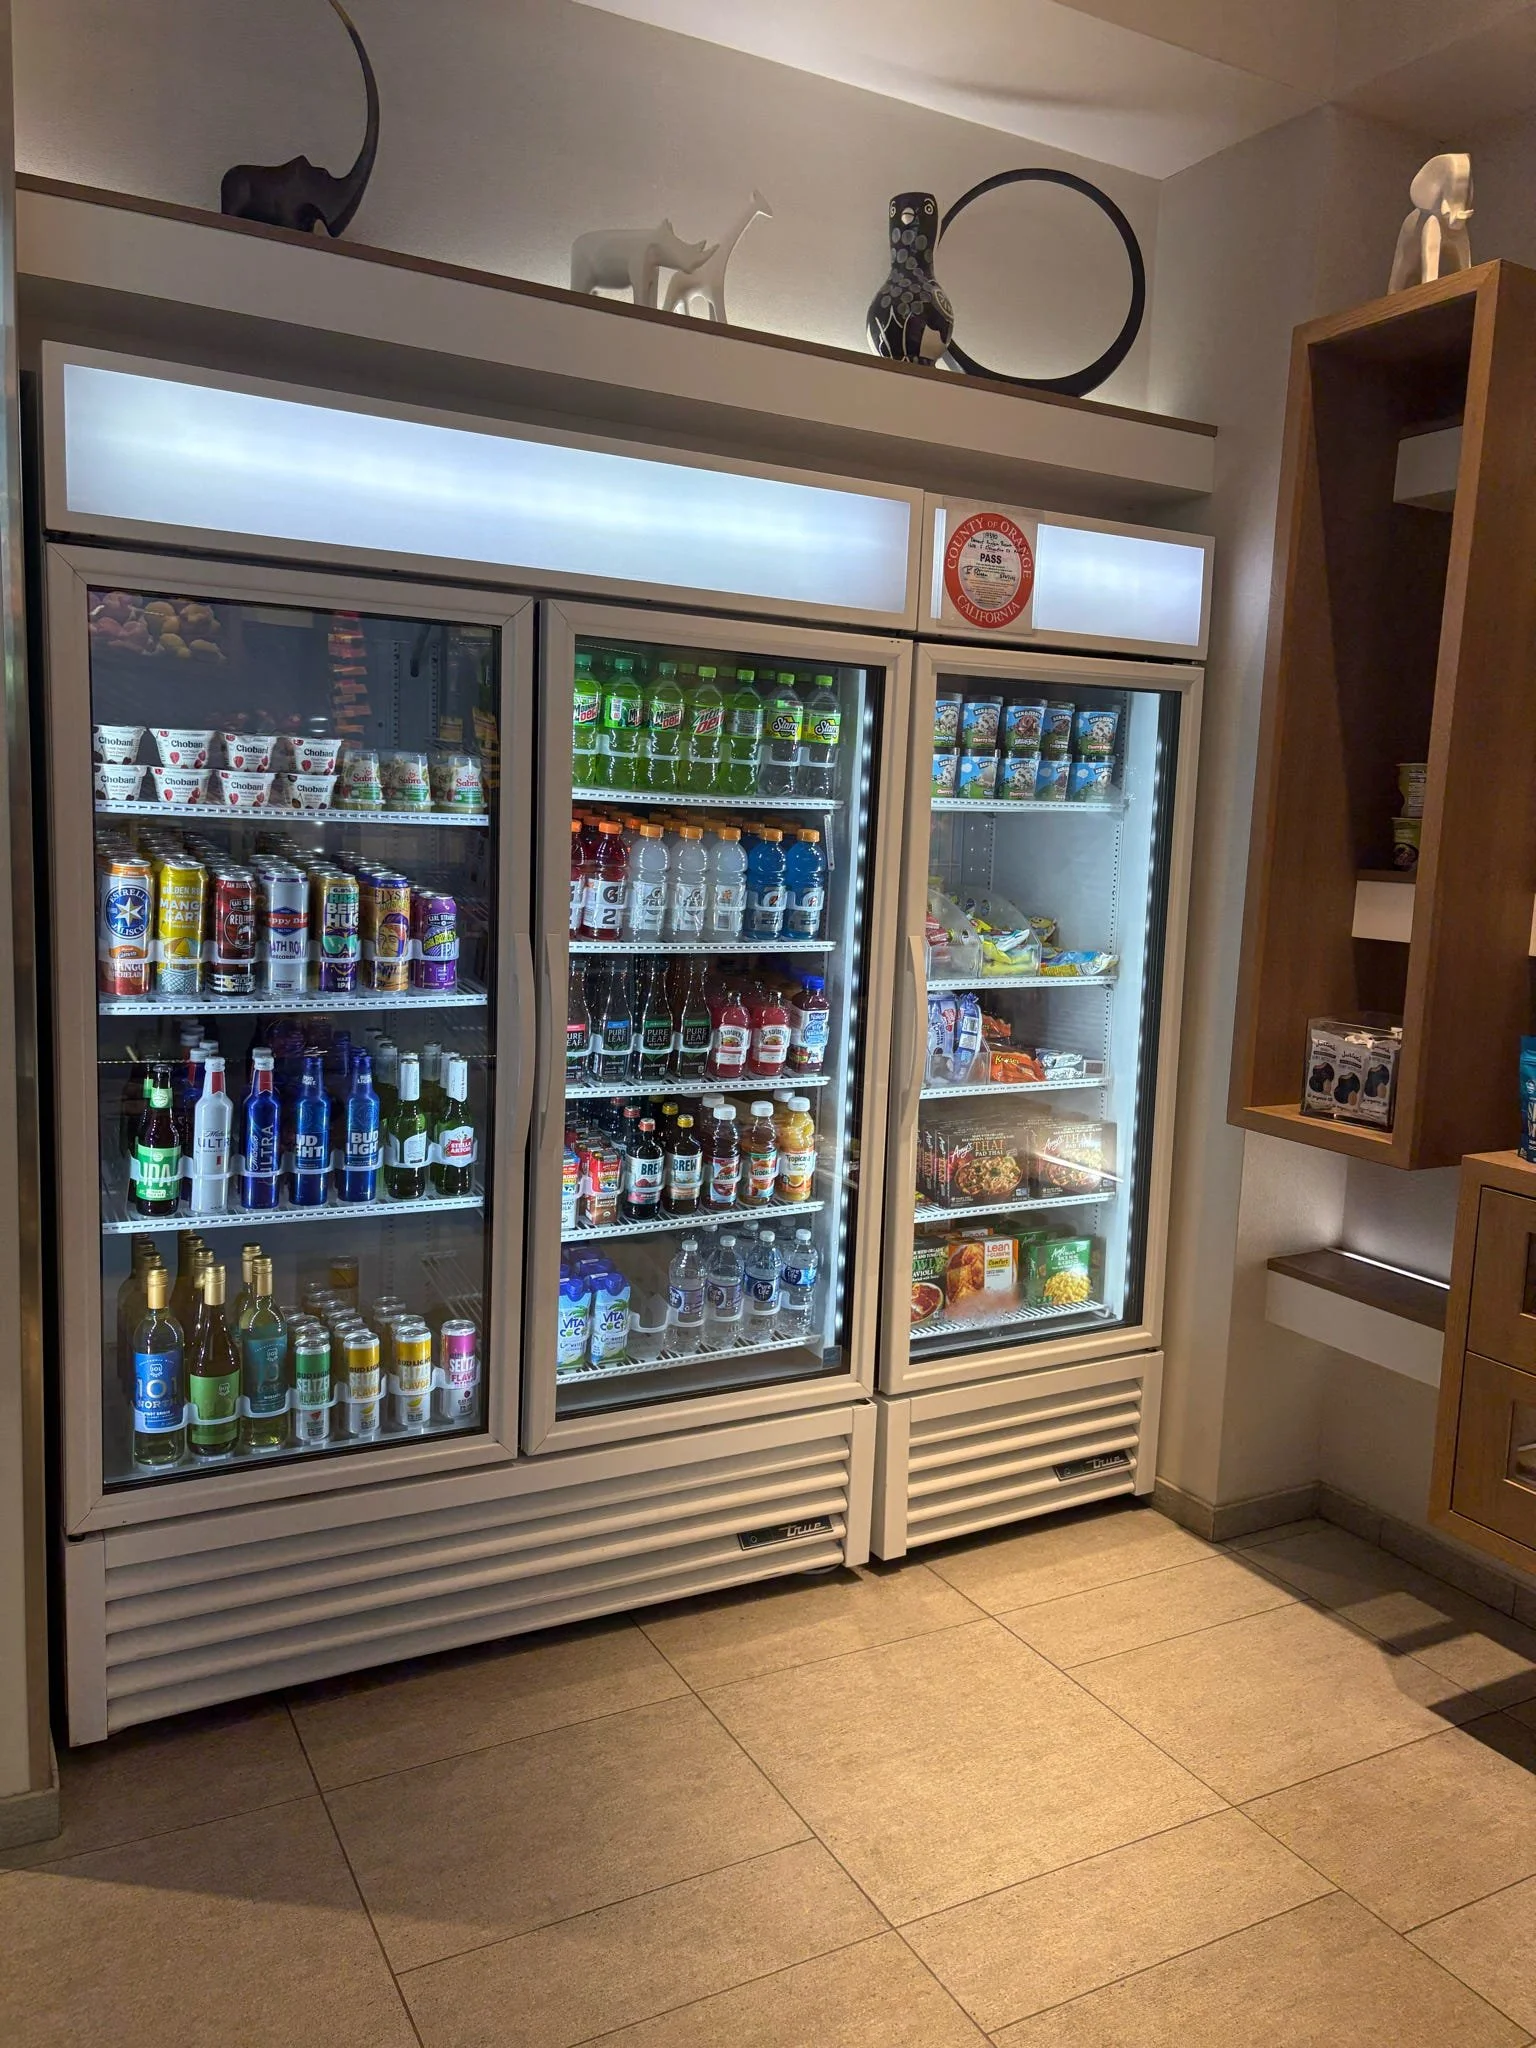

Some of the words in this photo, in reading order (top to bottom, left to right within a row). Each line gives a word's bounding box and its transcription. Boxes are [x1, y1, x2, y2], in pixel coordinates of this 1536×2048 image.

[947, 517, 984, 569] COUNTY
[1000, 521, 1032, 579] ORANGE
[980, 553, 1002, 565] PASS
[957, 595, 1021, 624] CALIFORNIA
[98, 737, 134, 746] Chobani
[171, 740, 204, 748] Choban
[236, 745, 269, 754] Chobani
[303, 749, 335, 757] Chobani
[100, 775, 137, 783] Chobani
[164, 777, 199, 786] Chobani
[352, 774, 377, 782] Sabra
[398, 776, 422, 784] Sabra
[456, 778, 480, 787] Sabra
[231, 782, 264, 791] Chobani
[297, 784, 329, 793] Chobani
[109, 889, 149, 904] ESTRELL
[374, 889, 410, 904] ELYSA
[160, 899, 202, 909] MANG
[166, 911, 201, 922] CART
[325, 914, 360, 928] HUG
[602, 909, 617, 925] 2
[111, 923, 146, 936] JALISCO
[566, 1032, 583, 1040] URE
[647, 1028, 668, 1036] PURE
[686, 1027, 707, 1035] PURE
[566, 1039, 582, 1047] EAF
[607, 1035, 625, 1043] LEAF
[685, 1034, 706, 1042] LEAF
[351, 1130, 379, 1144] BUD
[1064, 1132, 1093, 1144] THAI
[260, 1124, 275, 1172] ULTRA
[346, 1142, 379, 1155] LIGH
[451, 1141, 472, 1149] STELLA
[295, 1147, 324, 1158] GHT
[951, 1142, 974, 1162] Amy's
[973, 1140, 1005, 1151] THAI
[786, 1154, 811, 1163] Tropicaa
[673, 1158, 698, 1171] BREW
[143, 1162, 171, 1187] IPA
[987, 1243, 1010, 1253] Lean
[912, 1270, 934, 1278] AVIOLI
[603, 1311, 625, 1322] VITA
[563, 1317, 585, 1329] VITA
[136, 1376, 178, 1399] 101
[1086, 1455, 1125, 1469] True
[778, 1522, 827, 1537] True
